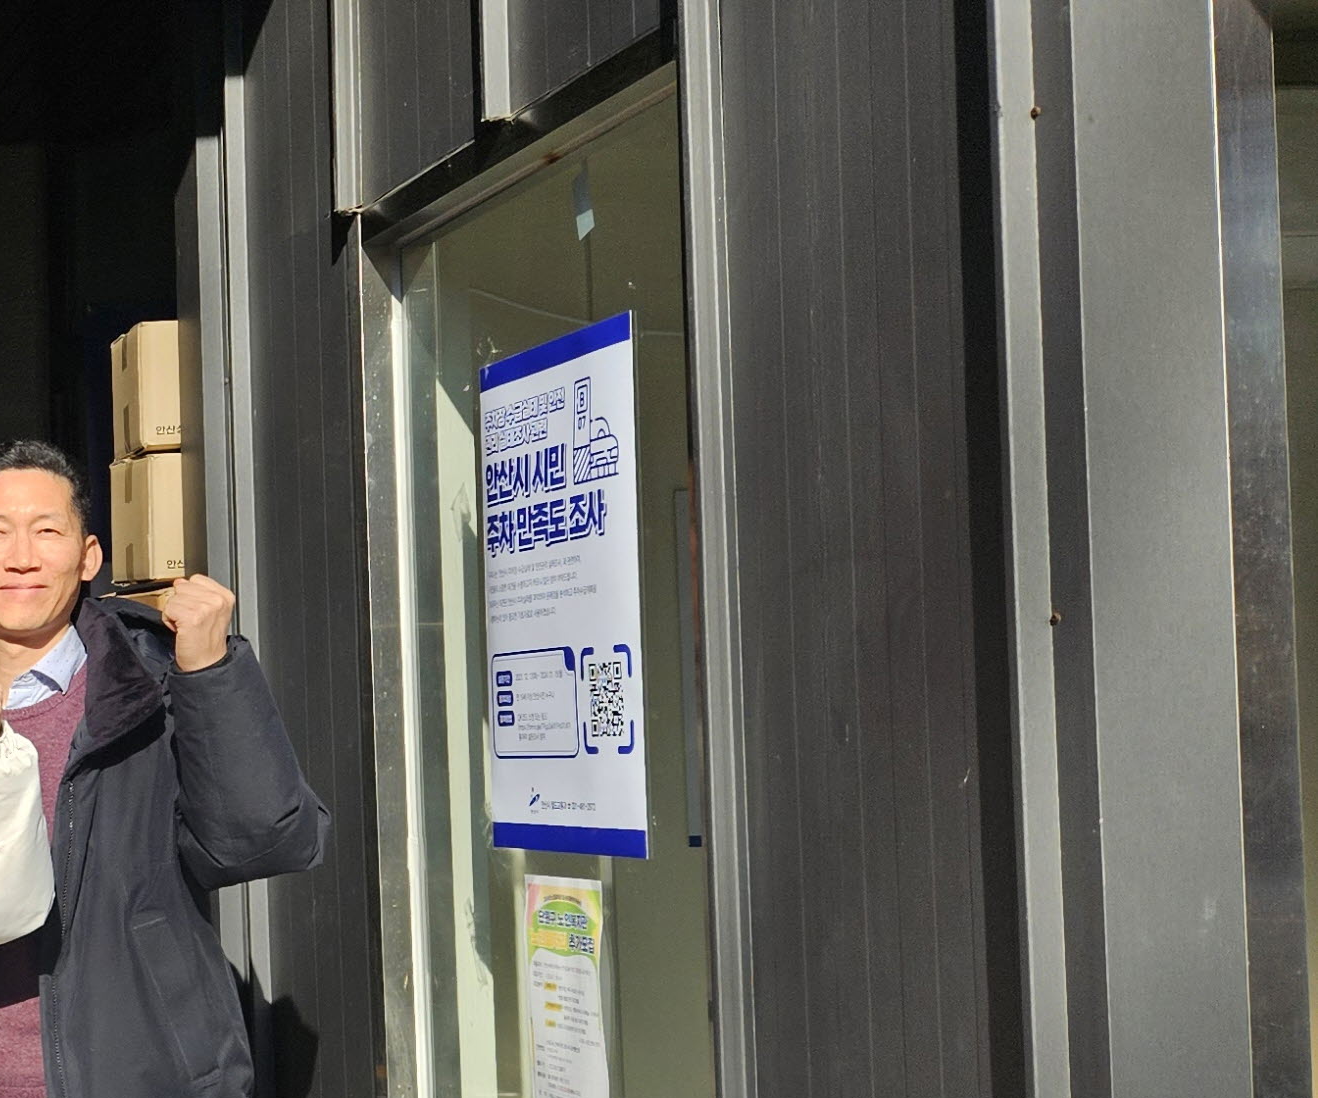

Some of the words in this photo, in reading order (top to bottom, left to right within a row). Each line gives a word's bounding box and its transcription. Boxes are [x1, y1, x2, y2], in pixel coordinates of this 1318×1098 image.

[486, 454, 530, 507] 안산시
[532, 443, 566, 493] 시민
[487, 511, 515, 557] 주차
[517, 499, 568, 551] 만족도
[569, 489, 606, 540] 조사
